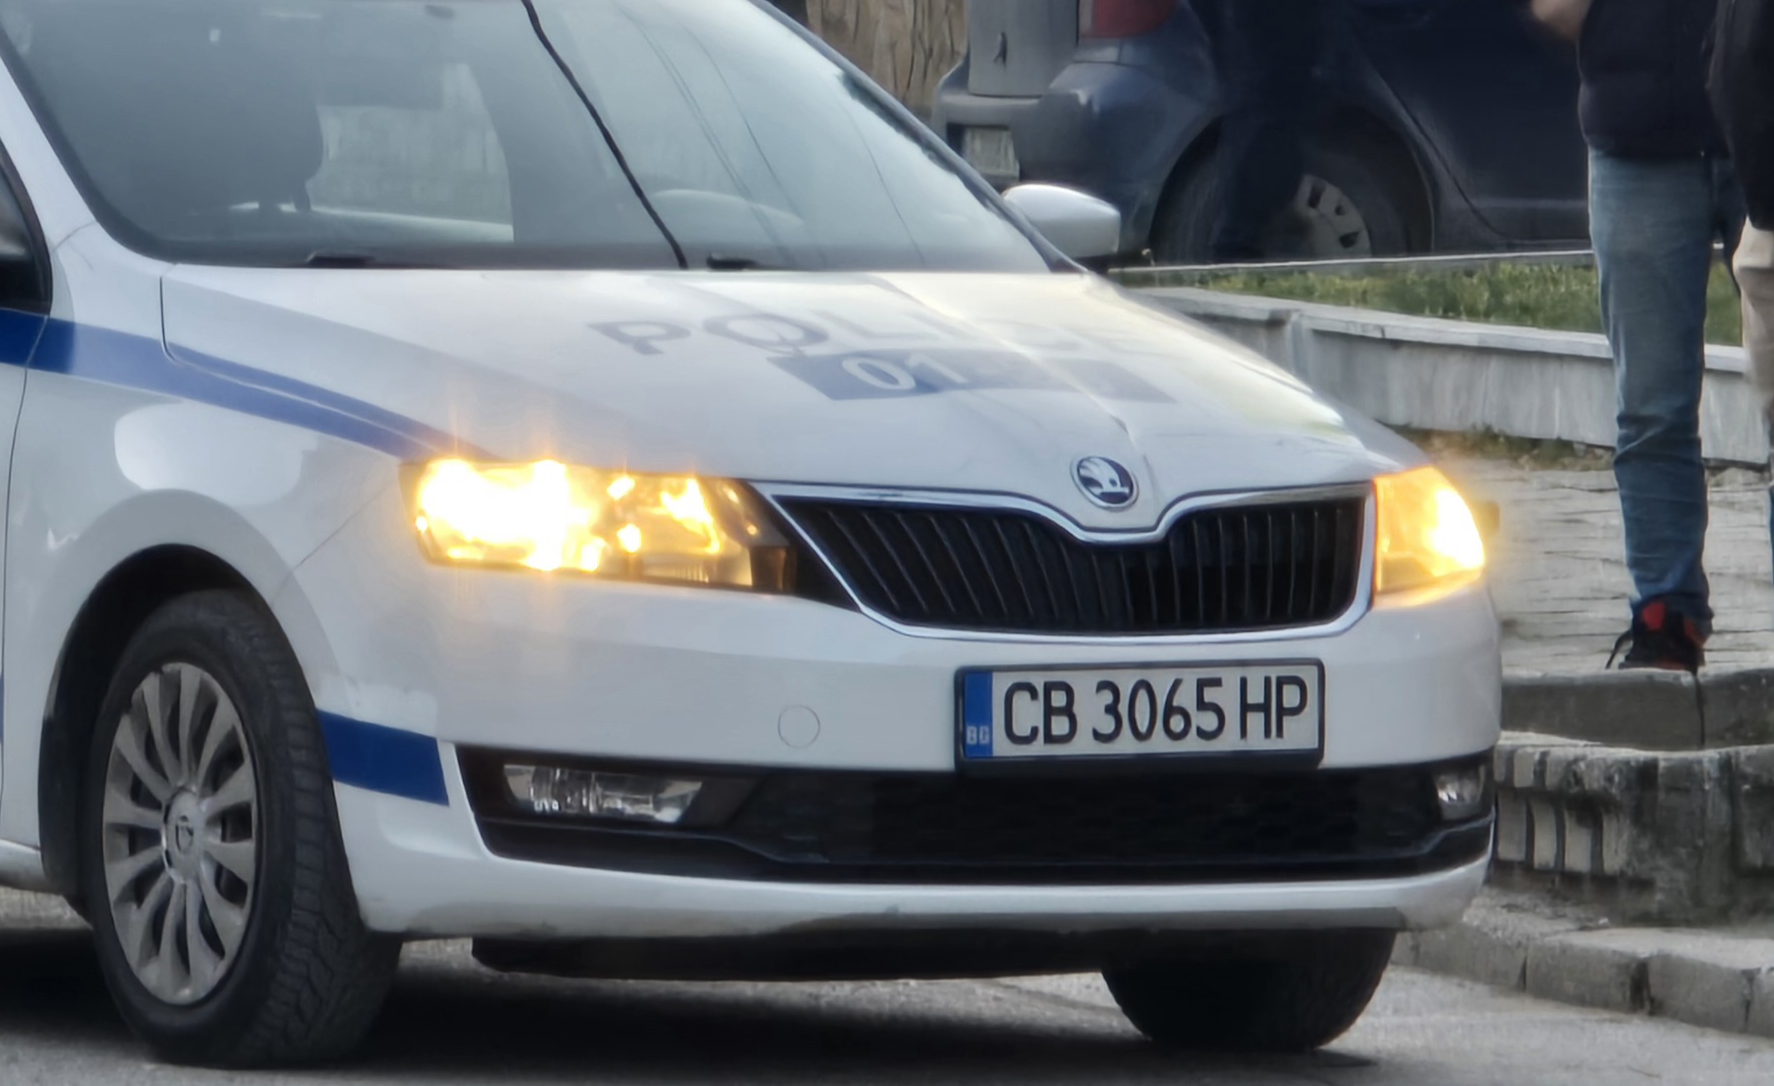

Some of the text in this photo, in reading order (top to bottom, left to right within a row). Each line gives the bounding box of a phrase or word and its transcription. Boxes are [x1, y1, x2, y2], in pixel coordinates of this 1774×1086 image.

[1003, 674, 1308, 746] CB 3065 HP
